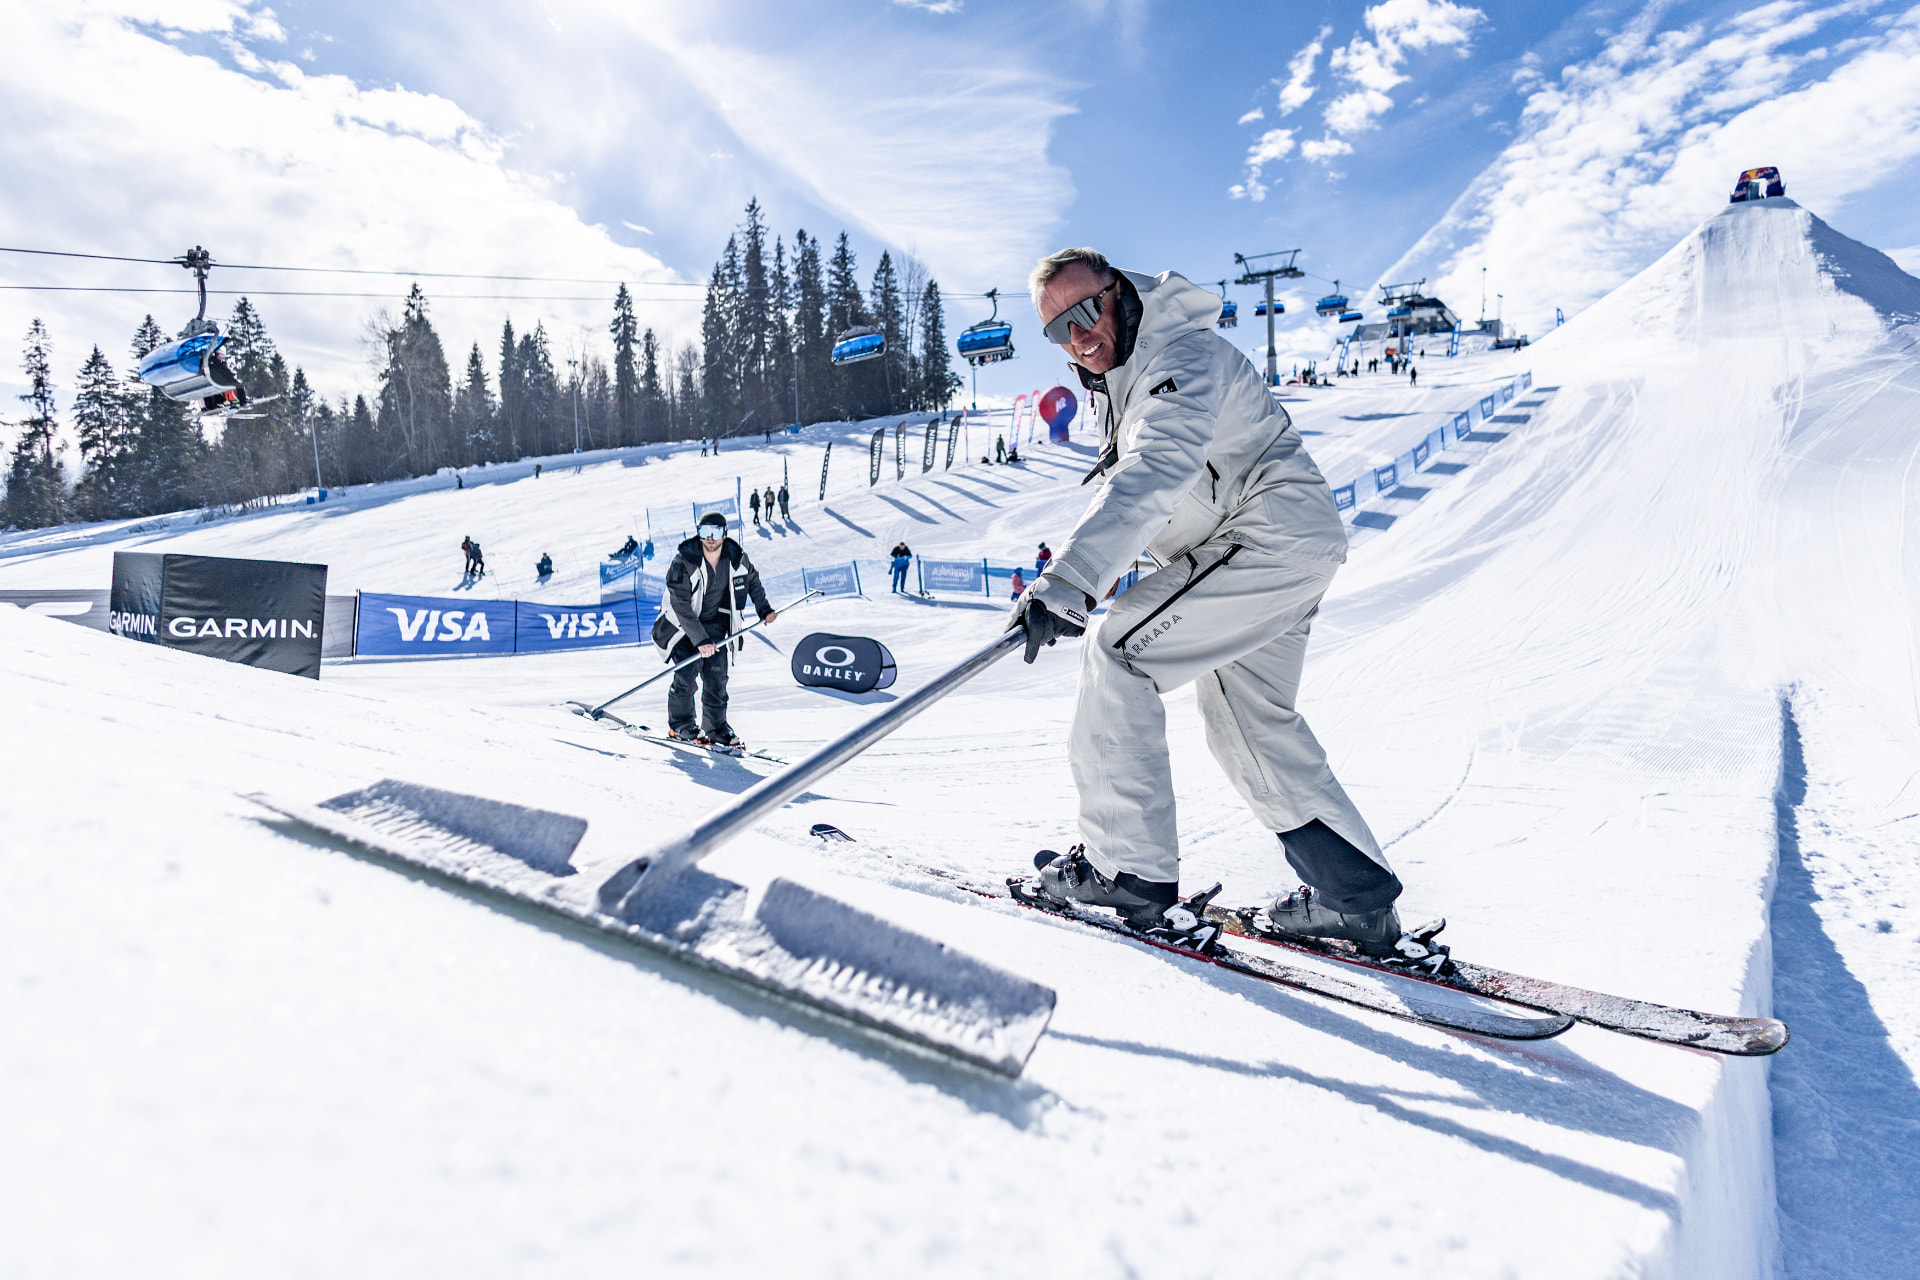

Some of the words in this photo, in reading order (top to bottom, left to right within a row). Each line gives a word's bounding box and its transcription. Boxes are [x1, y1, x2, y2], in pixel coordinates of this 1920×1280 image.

[871, 440, 881, 478] GARMIN
[926, 429, 936, 466] GARMIN
[110, 610, 156, 635] GARMIN
[168, 617, 316, 639] GARMIN
[386, 607, 491, 642] VISA
[537, 611, 619, 640] VISA
[803, 664, 862, 681] OAKLEY
